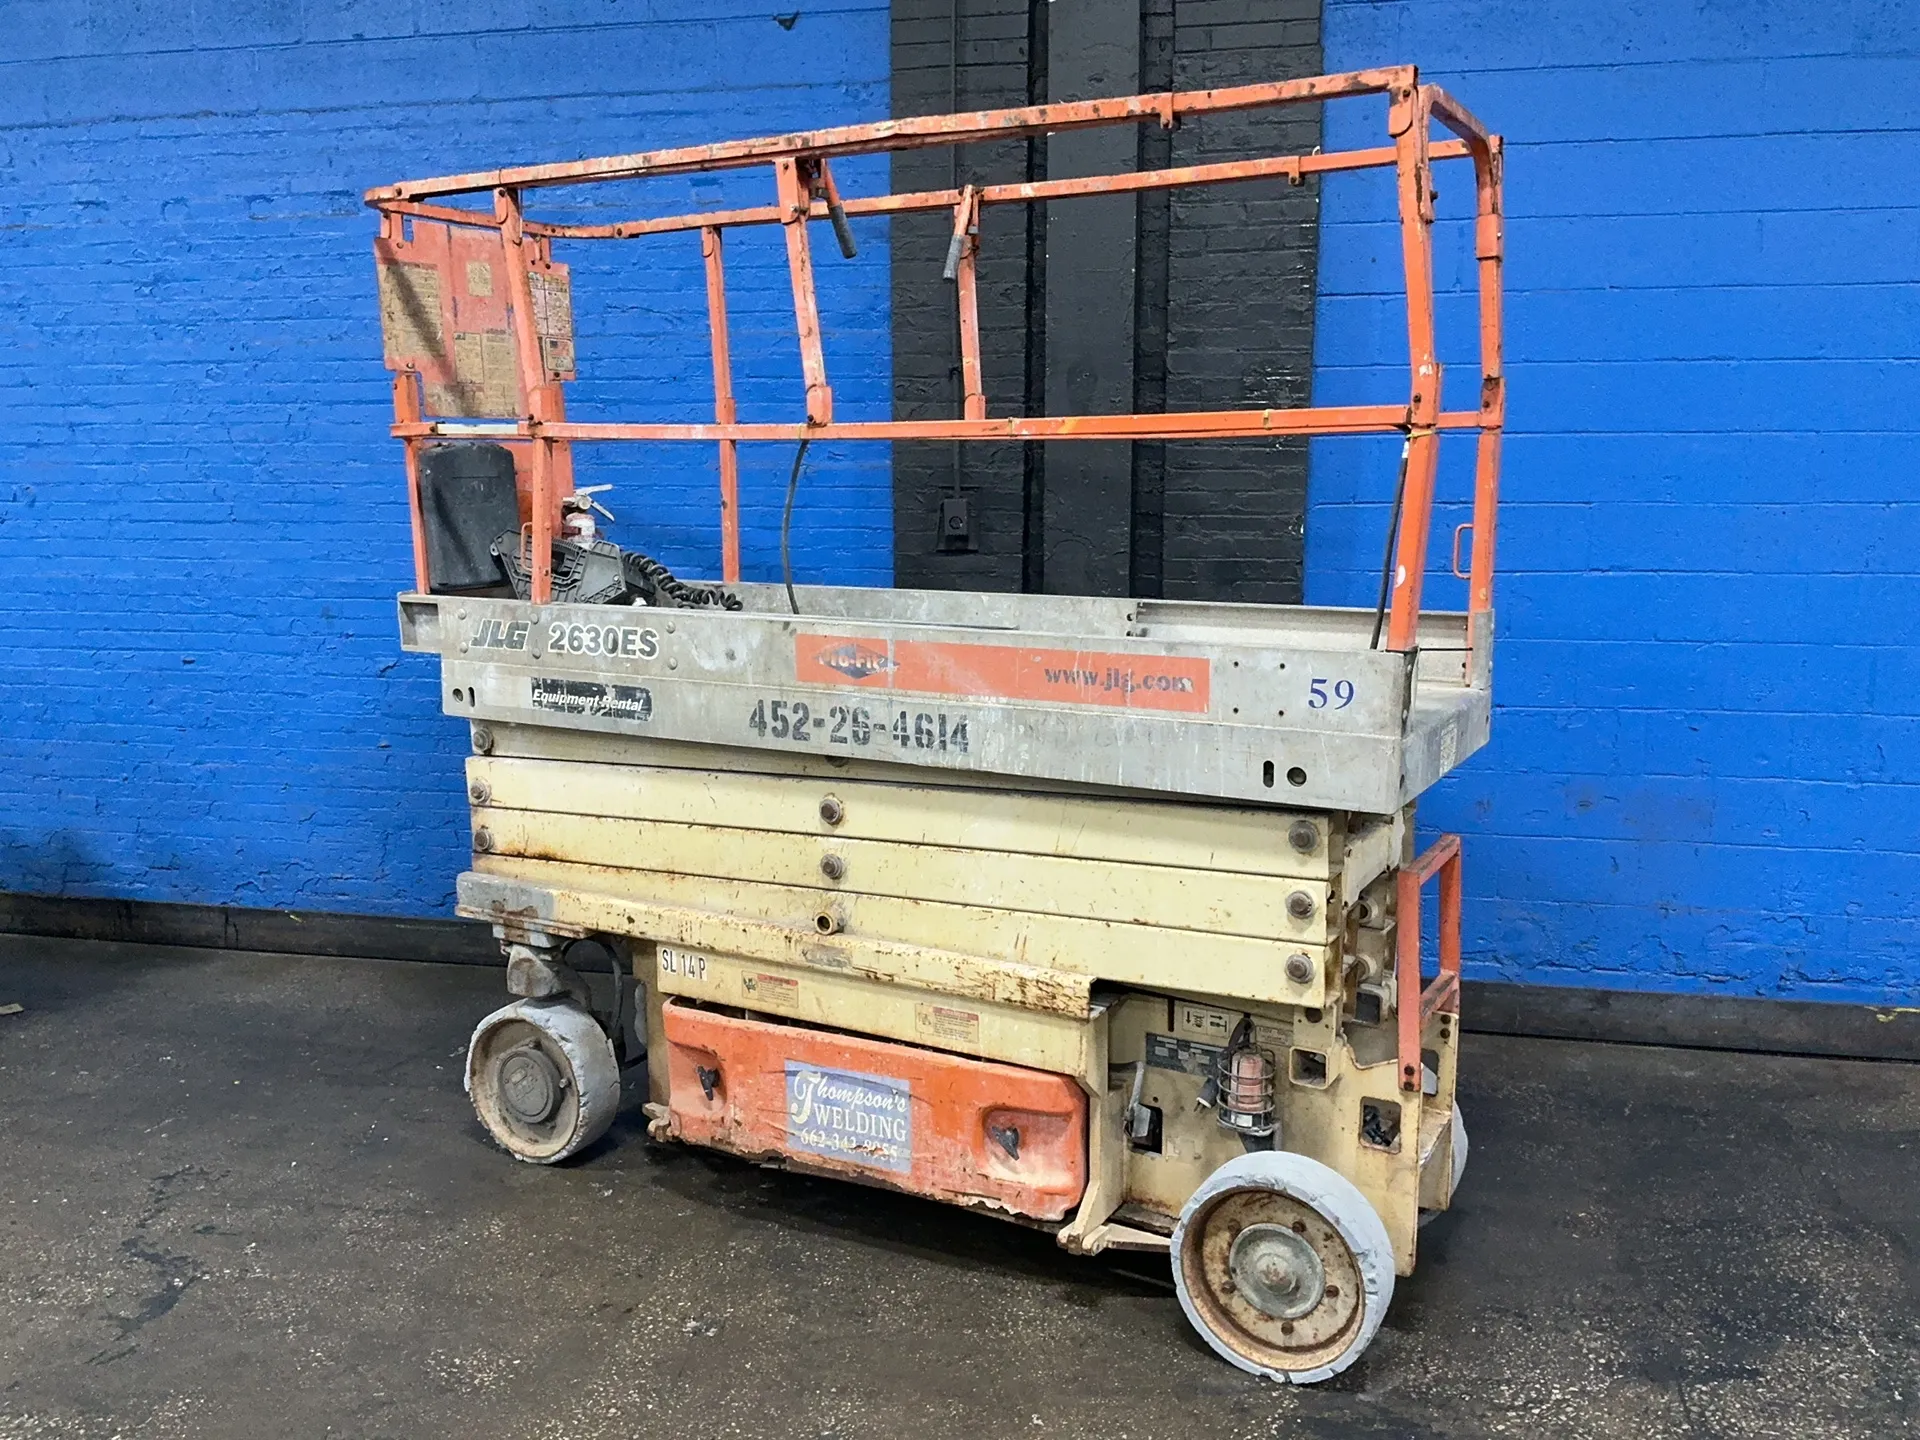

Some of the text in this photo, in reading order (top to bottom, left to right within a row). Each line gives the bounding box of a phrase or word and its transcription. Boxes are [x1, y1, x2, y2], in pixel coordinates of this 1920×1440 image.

[470, 618, 532, 651] JLG
[547, 621, 660, 660] 2630ES
[1045, 666, 1194, 694] www.jlg.com
[1307, 678, 1356, 711] 59
[532, 688, 643, 711] Equipment Rental
[747, 698, 971, 755] 452-26-4614
[662, 949, 677, 973] SL
[791, 1070, 908, 1125] Thompson's
[813, 1103, 907, 1142] WELDING
